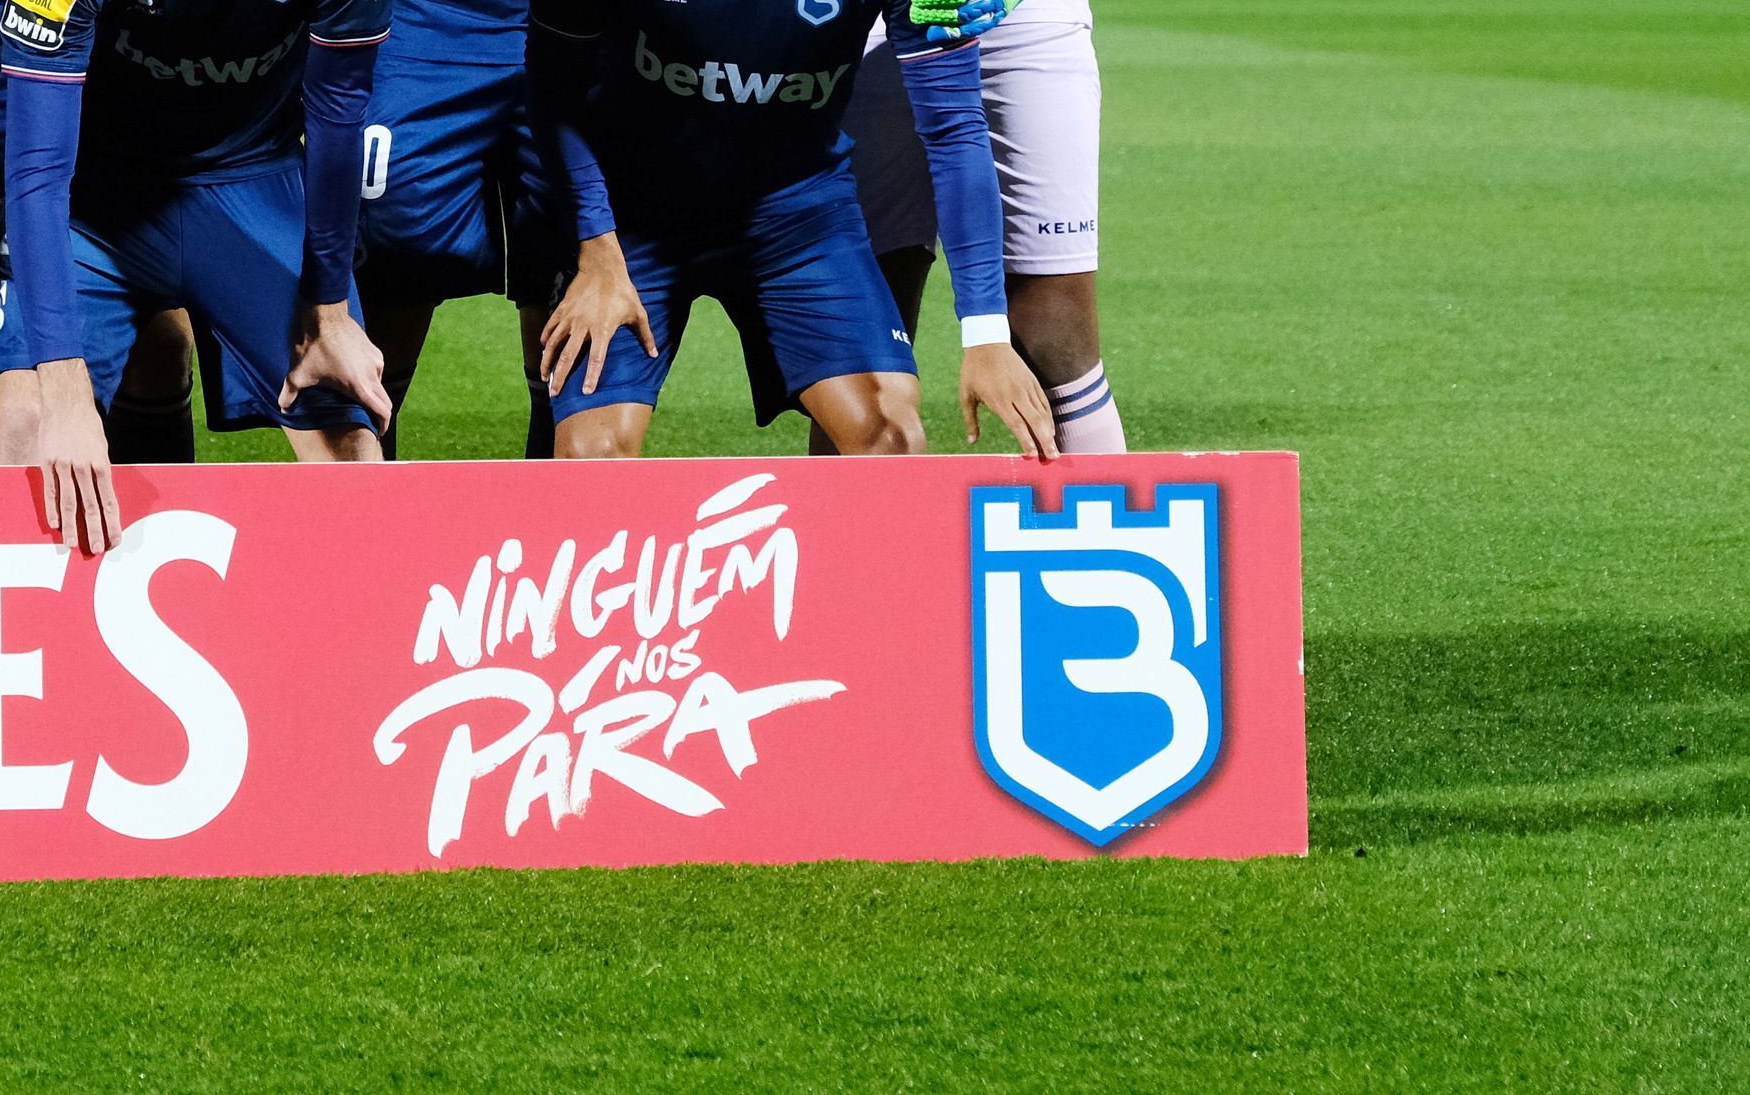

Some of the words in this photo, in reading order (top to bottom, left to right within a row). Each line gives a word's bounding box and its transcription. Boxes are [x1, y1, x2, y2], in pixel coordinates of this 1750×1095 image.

[5, 5, 57, 43] bwin
[635, 29, 851, 110] betway
[1038, 219, 1096, 235] KELME
